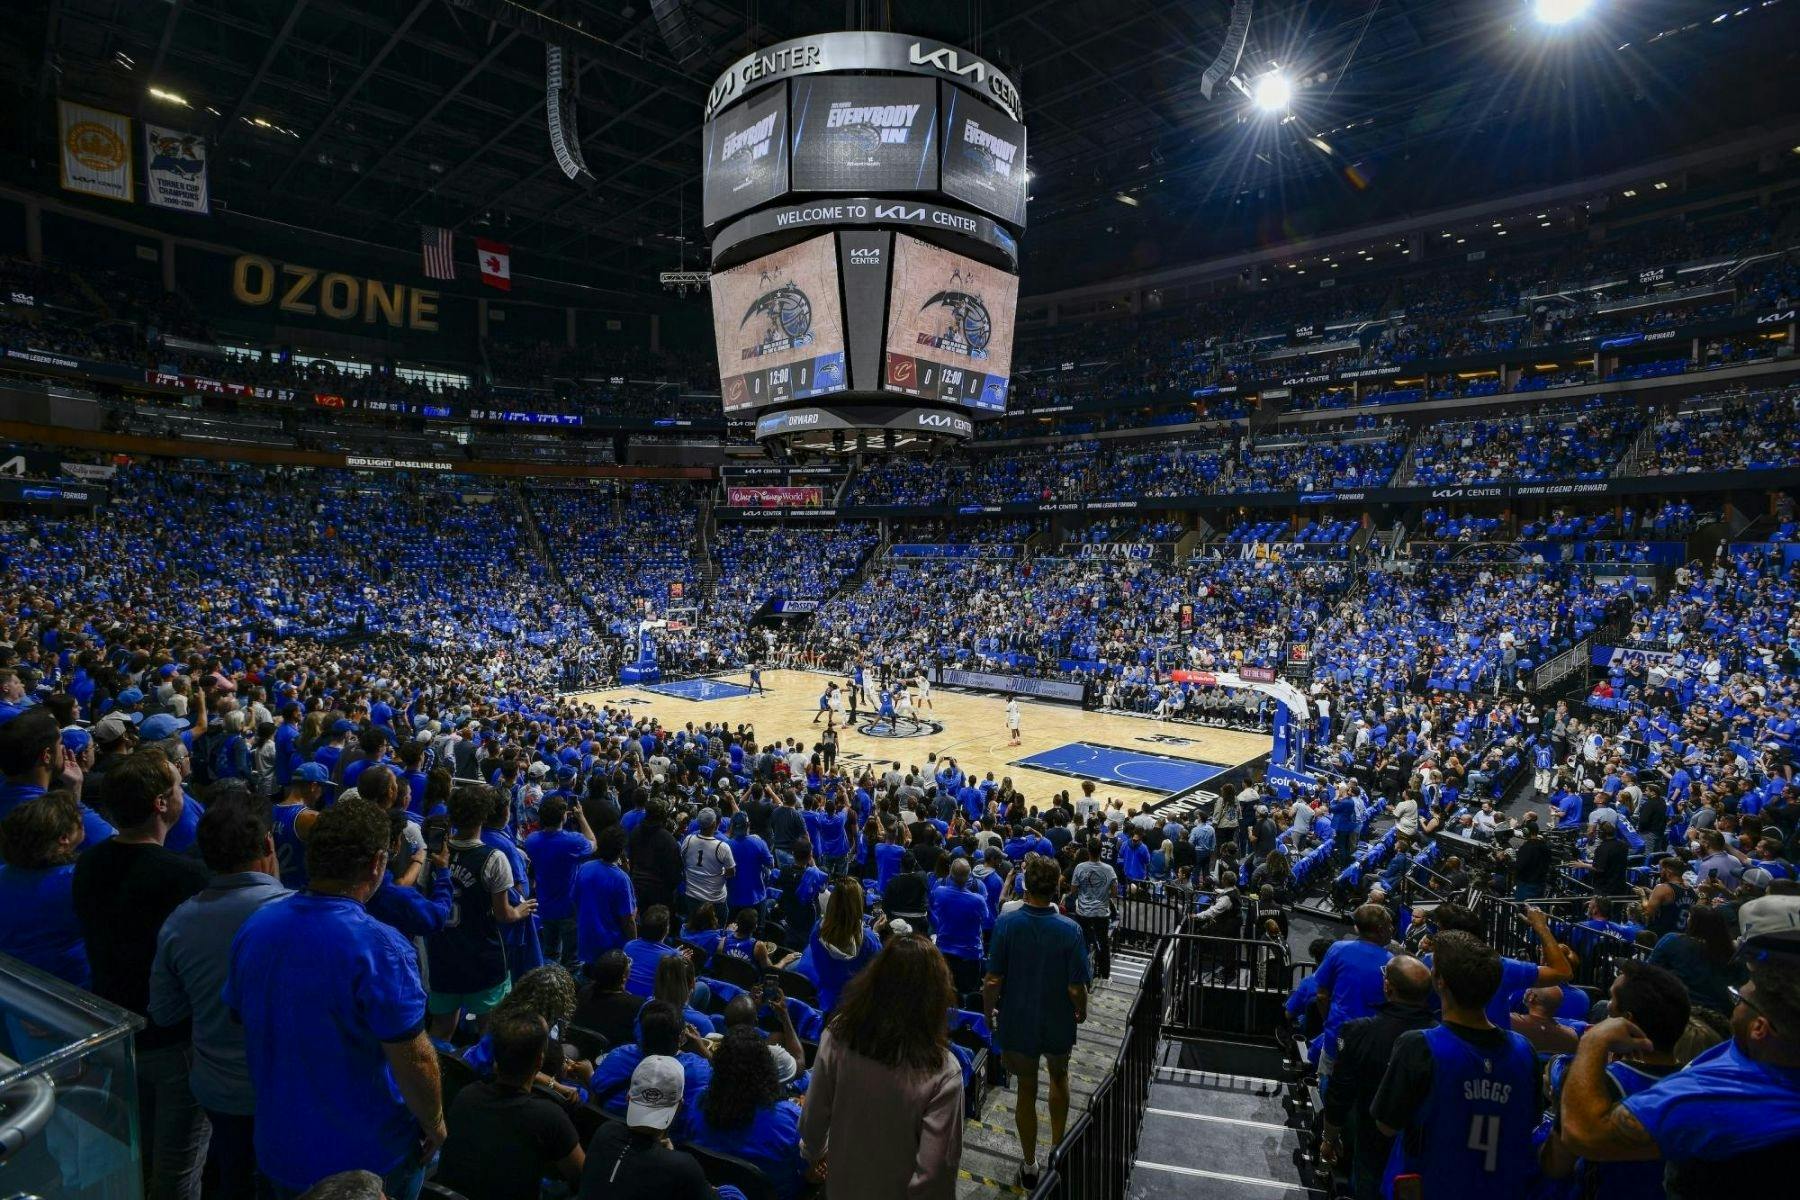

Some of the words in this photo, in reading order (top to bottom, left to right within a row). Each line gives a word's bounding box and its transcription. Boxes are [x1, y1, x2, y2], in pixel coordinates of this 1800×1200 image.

[742, 44, 821, 84] CENTER
[910, 42, 985, 82] KIA
[827, 104, 920, 128] EVERYBODY
[881, 128, 909, 143] IN
[158, 187, 199, 201] CHAMPIONS
[777, 206, 842, 226] WELCOME
[846, 206, 866, 218] TO
[875, 205, 925, 220] KIA
[932, 211, 977, 232] CENTER
[851, 248, 880, 257] KIA
[851, 257, 880, 265] CENTER
[232, 253, 440, 332] OZONE
[1757, 310, 1795, 324] KIA
[1644, 331, 1675, 341] FORWARD
[770, 368, 789, 386] 12:00
[941, 368, 962, 385] 12:00
[1306, 375, 1329, 383] CENTER
[788, 413, 819, 426] ORWARD
[918, 413, 951, 427] KIA
[367, 459, 392, 467] LIGHT
[395, 460, 433, 469] BASELINE
[1432, 489, 1463, 498] KIA
[1467, 488, 1501, 497] CENTER
[1517, 487, 1545, 495] DRIVING
[1546, 485, 1572, 493] LEGEND
[1573, 483, 1608, 493] FORWARD
[783, 493, 803, 502] World
[1151, 789, 1220, 819] ORLAND
[697, 850, 703, 867] 1
[1463, 1079, 1513, 1105] SUGGS
[1467, 1114, 1501, 1172] 4
